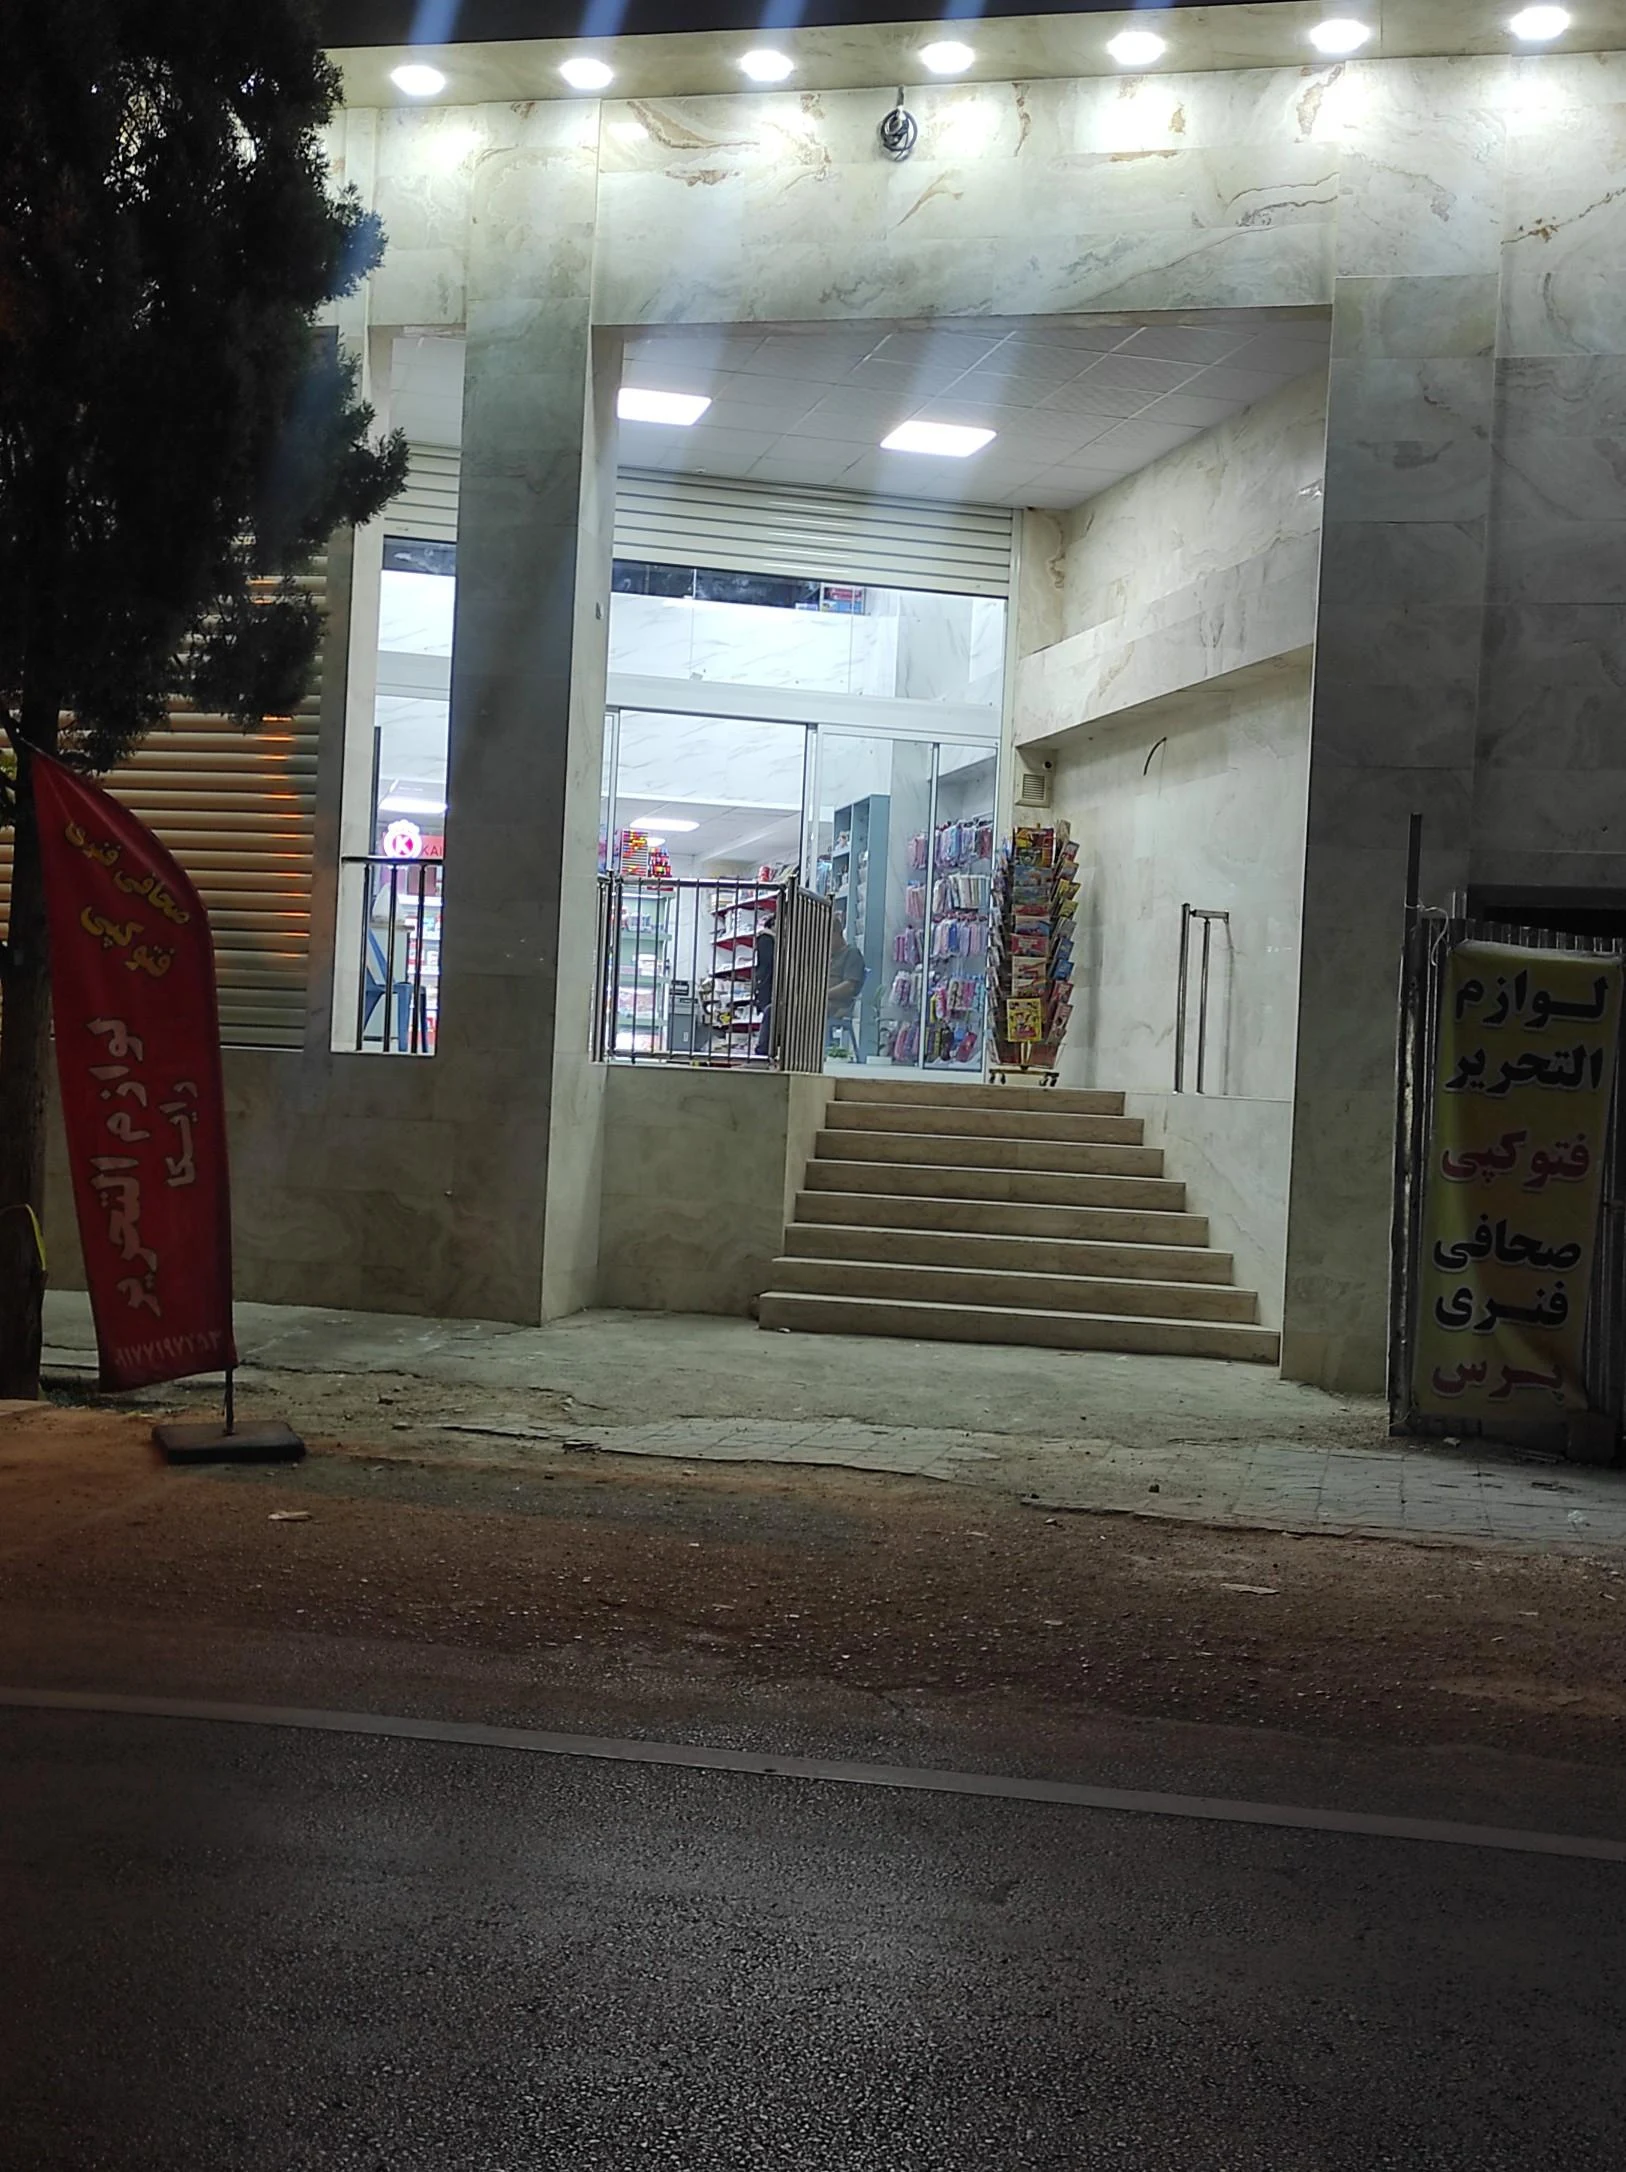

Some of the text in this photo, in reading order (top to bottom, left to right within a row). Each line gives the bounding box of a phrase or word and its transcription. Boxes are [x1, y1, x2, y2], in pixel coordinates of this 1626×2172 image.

[1454, 968, 1609, 1029] لوازم
[86, 1017, 151, 1143] لوازم
[1445, 1043, 1605, 1095] التحریر
[1433, 1212, 1582, 1269] صحافی
[1435, 1280, 1569, 1331] فنری
